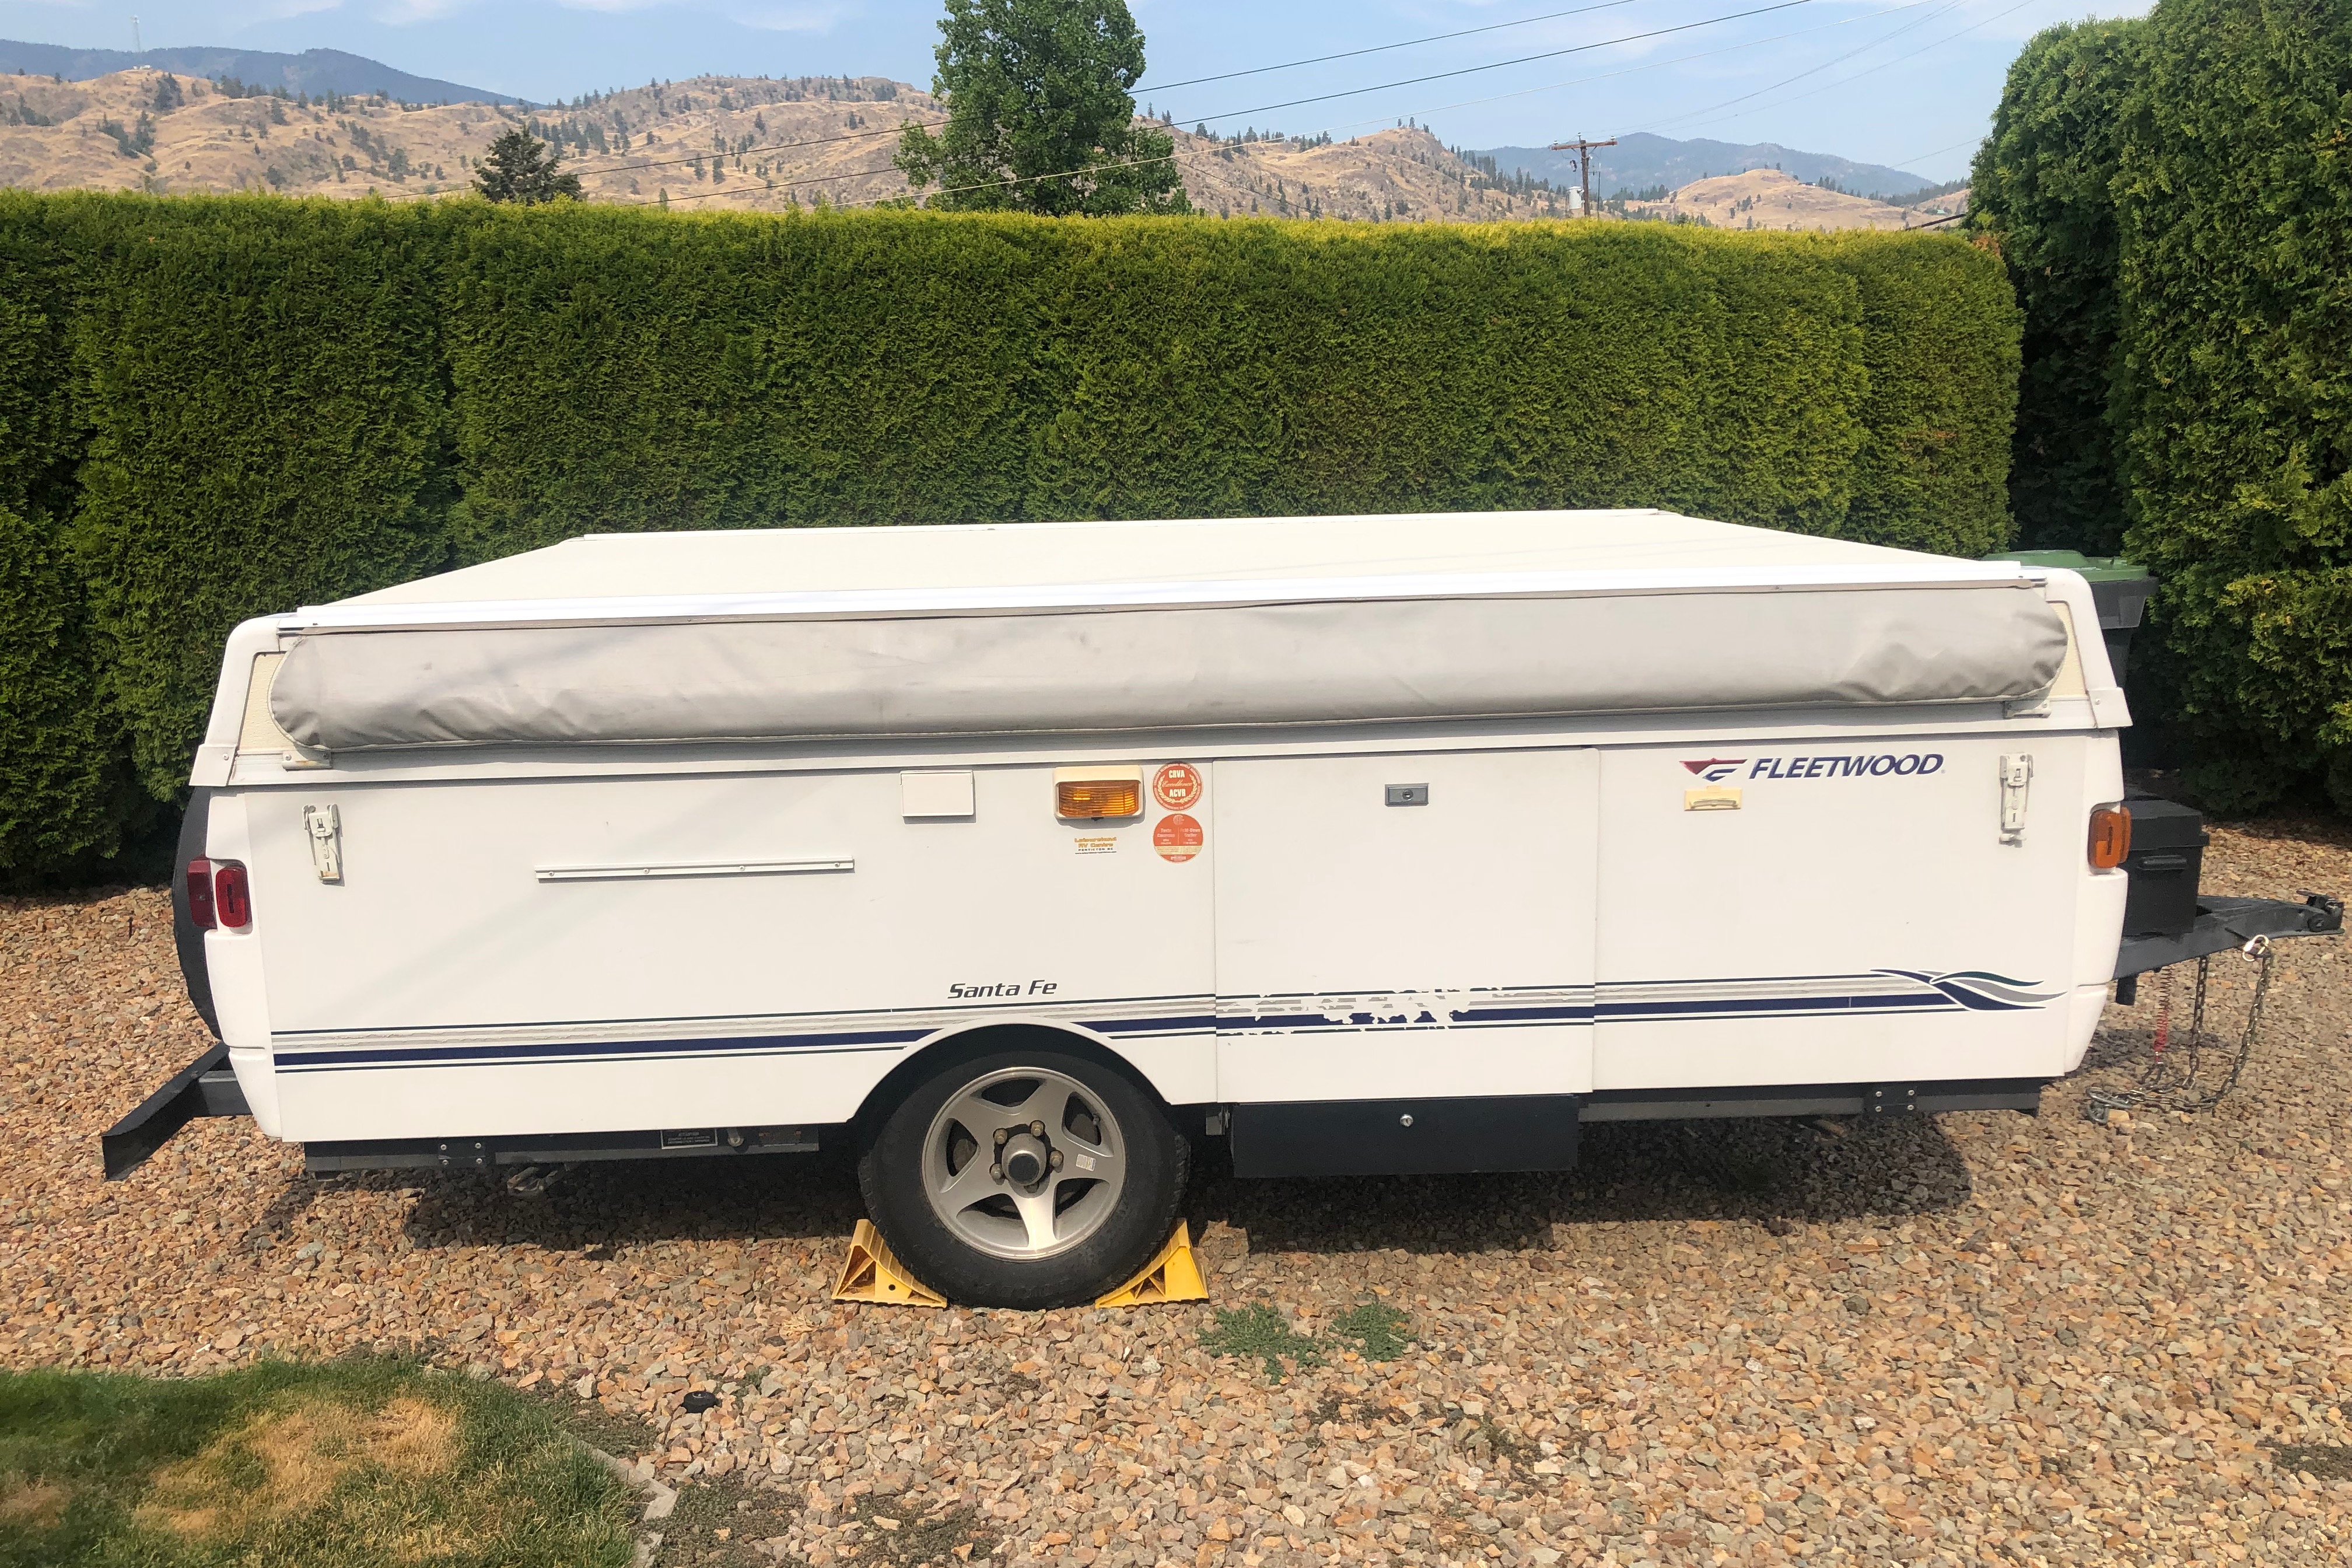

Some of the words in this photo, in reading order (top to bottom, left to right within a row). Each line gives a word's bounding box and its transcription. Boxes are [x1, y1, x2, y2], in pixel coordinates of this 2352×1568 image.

[1748, 754, 1944, 779] FLEETWOOD
[947, 982, 1020, 999] Santa
[1028, 979, 1058, 995] Fe
